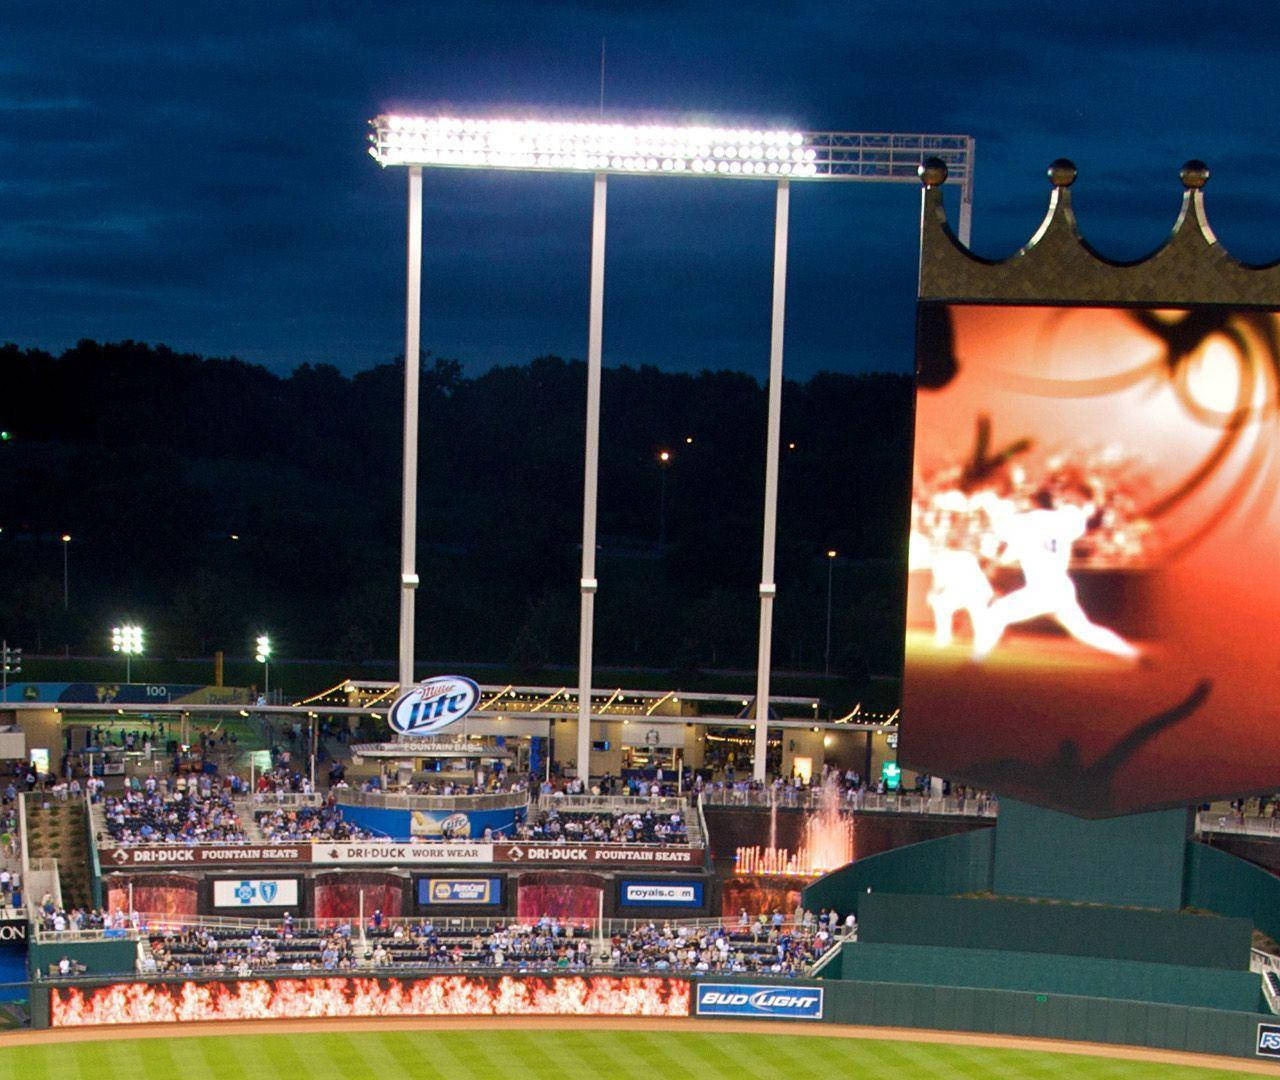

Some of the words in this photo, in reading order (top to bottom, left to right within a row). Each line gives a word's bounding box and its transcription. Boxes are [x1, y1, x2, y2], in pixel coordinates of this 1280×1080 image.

[146, 686, 166, 697] 100
[407, 692, 467, 731] Lite
[201, 849, 260, 860] FOUNTAIN
[262, 849, 299, 860] SEATS
[412, 848, 444, 858] WORK
[447, 848, 479, 858] WEAR
[595, 849, 653, 861] FOUNTAIN
[654, 851, 691, 862] SEATS
[701, 992, 749, 1005] BUD
[756, 996, 818, 1008] LIGHT
